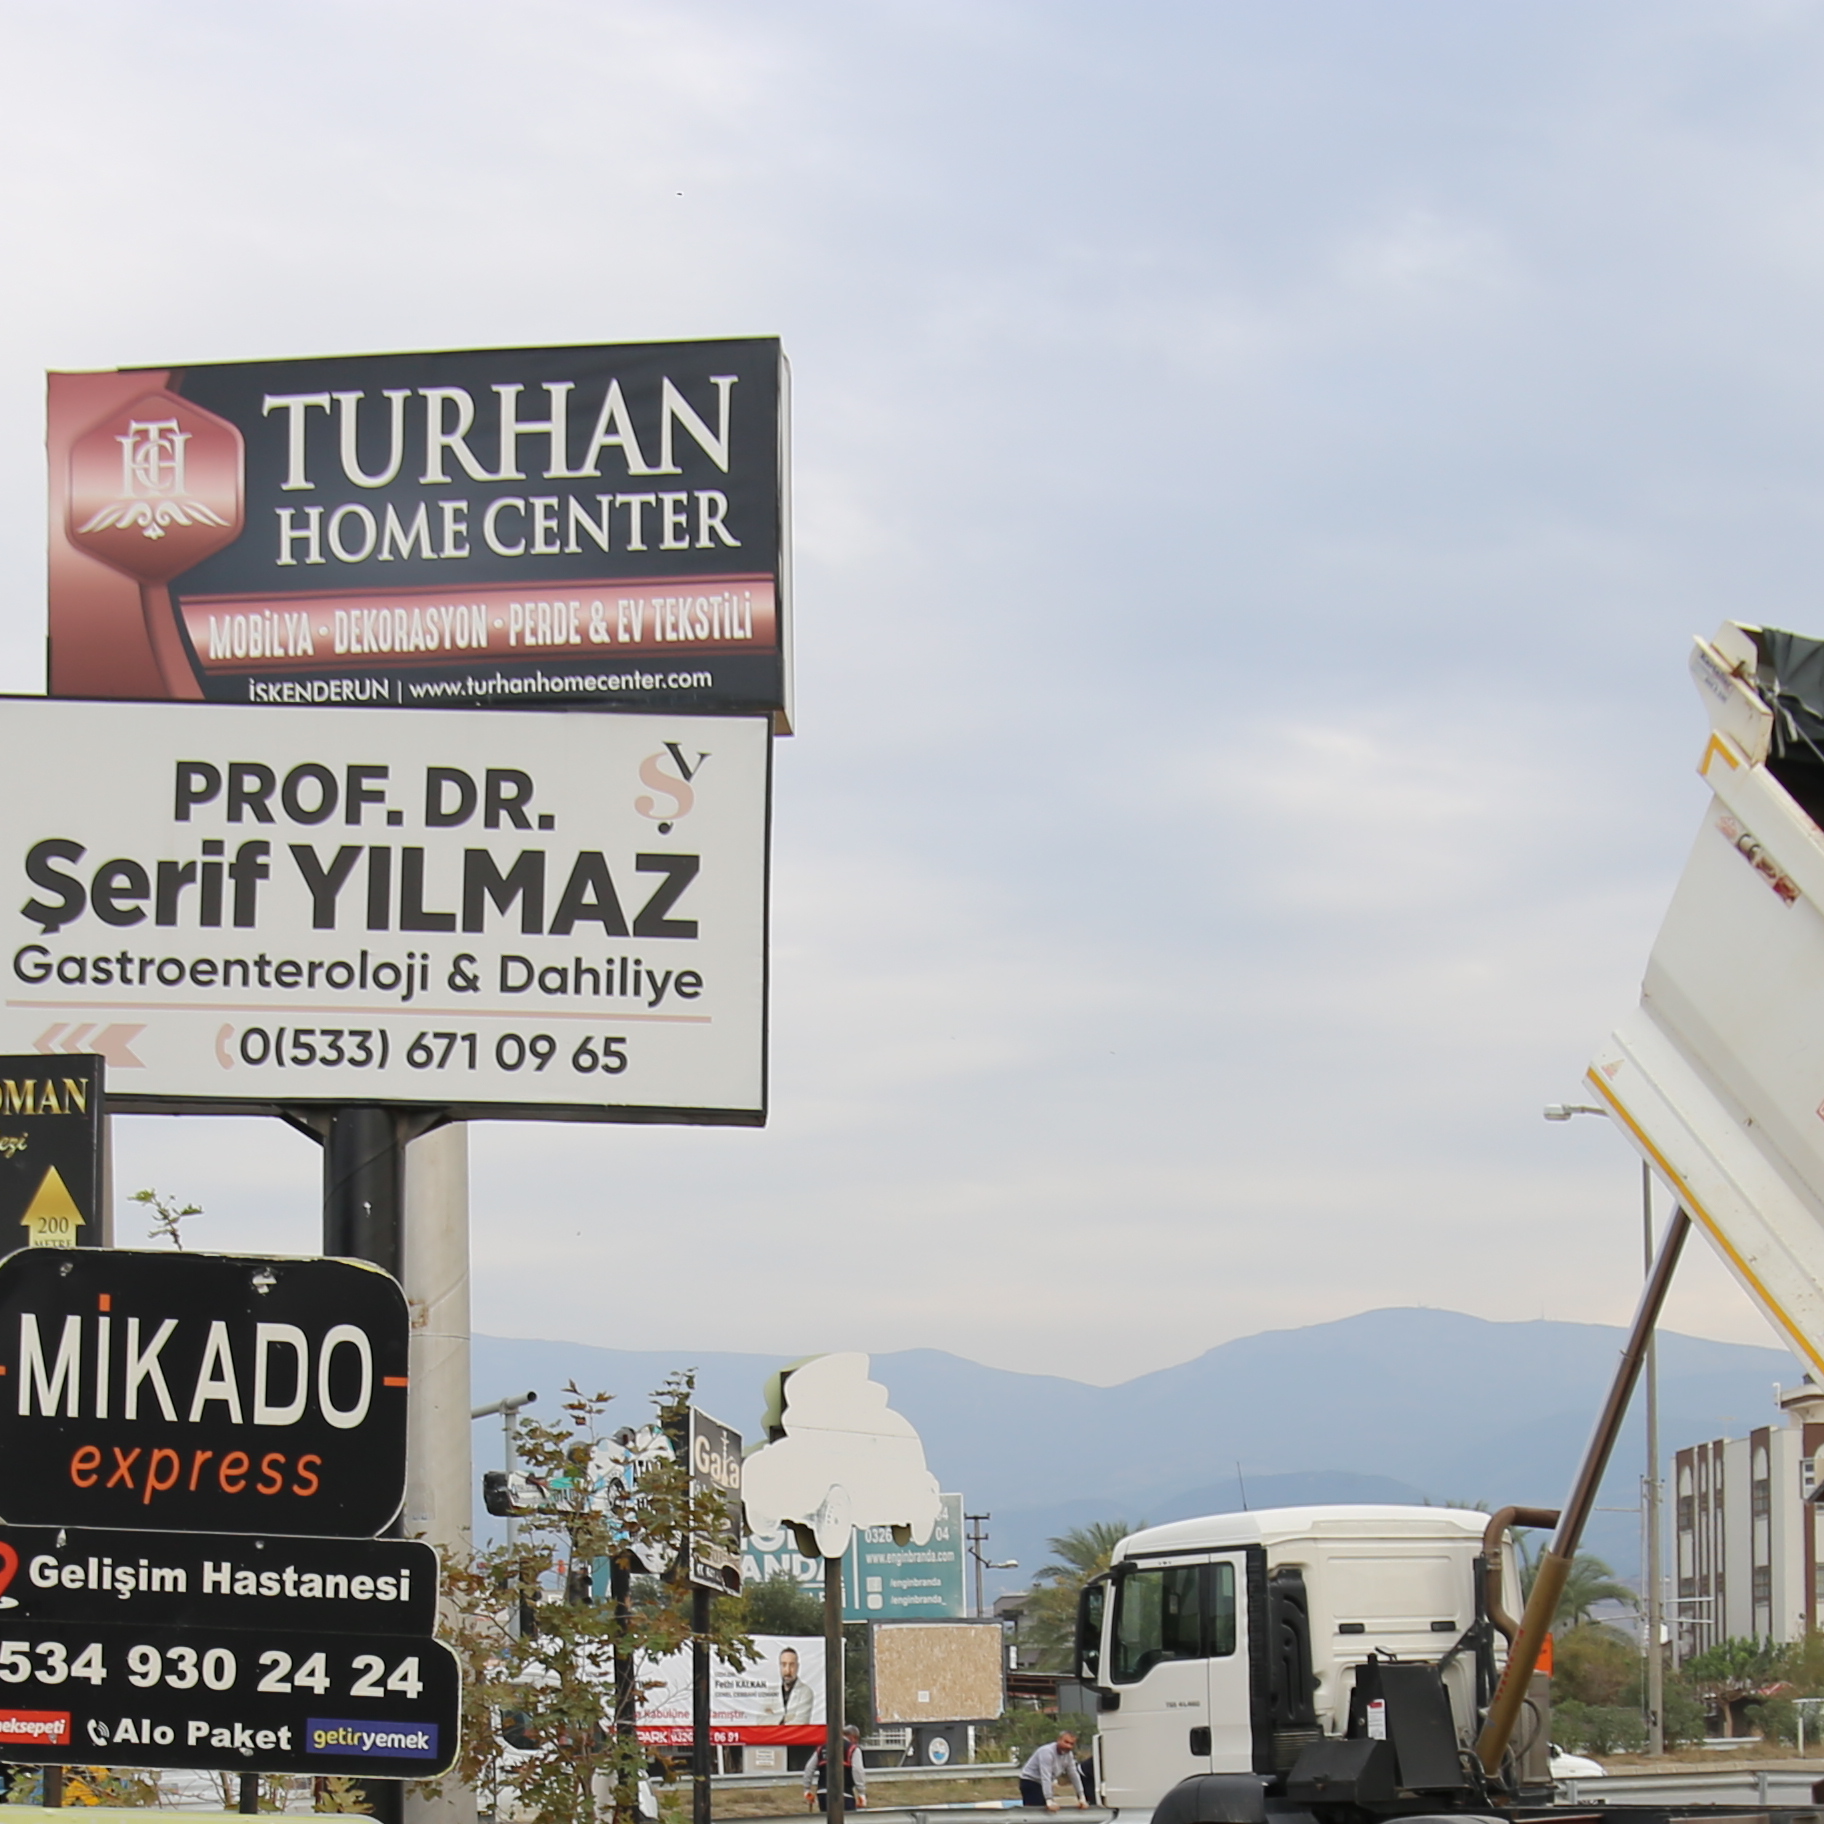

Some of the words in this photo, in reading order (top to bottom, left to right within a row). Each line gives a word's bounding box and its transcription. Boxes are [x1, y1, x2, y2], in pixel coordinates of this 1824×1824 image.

[261, 374, 739, 491] TURHAN
[275, 497, 471, 567] HOME
[482, 490, 742, 559] CENTER
[208, 607, 314, 660] MOBİLYA
[332, 603, 489, 656] DEKORASYON
[507, 599, 581, 647] PERDE
[589, 601, 611, 645] &
[616, 598, 648, 642] EV
[652, 590, 753, 642] TEKSTİLİ
[248, 677, 390, 704] İSKENDERUN
[409, 668, 713, 700] www.turhanhomecenter.com
[174, 760, 404, 827] PROF.
[423, 767, 556, 832] DR.
[20, 838, 271, 936] Şerif
[288, 842, 701, 940] YILMAZ
[13, 943, 430, 1001] Gastroenteroloji
[446, 953, 482, 993] &
[498, 955, 703, 1007] Dahiliye
[238, 1025, 390, 1071] 0(533)
[406, 1031, 478, 1073] 671
[494, 1033, 558, 1073] 09
[571, 1035, 629, 1075] 65
[37, 1215, 69, 1236] 200
[18, 1294, 374, 1430] MİKADO
[70, 1445, 323, 1504] express
[29, 1555, 188, 1599] Gelişim
[203, 1561, 412, 1602] Hastanesi
[865, 1549, 954, 1566] www.enginbranda.com
[127, 1644, 238, 1691] 930
[257, 1651, 330, 1695] 24
[350, 1655, 424, 1700] 24
[113, 1717, 175, 1746] Alo
[187, 1720, 292, 1751] Paket
[313, 1727, 430, 1752] getiryemek
